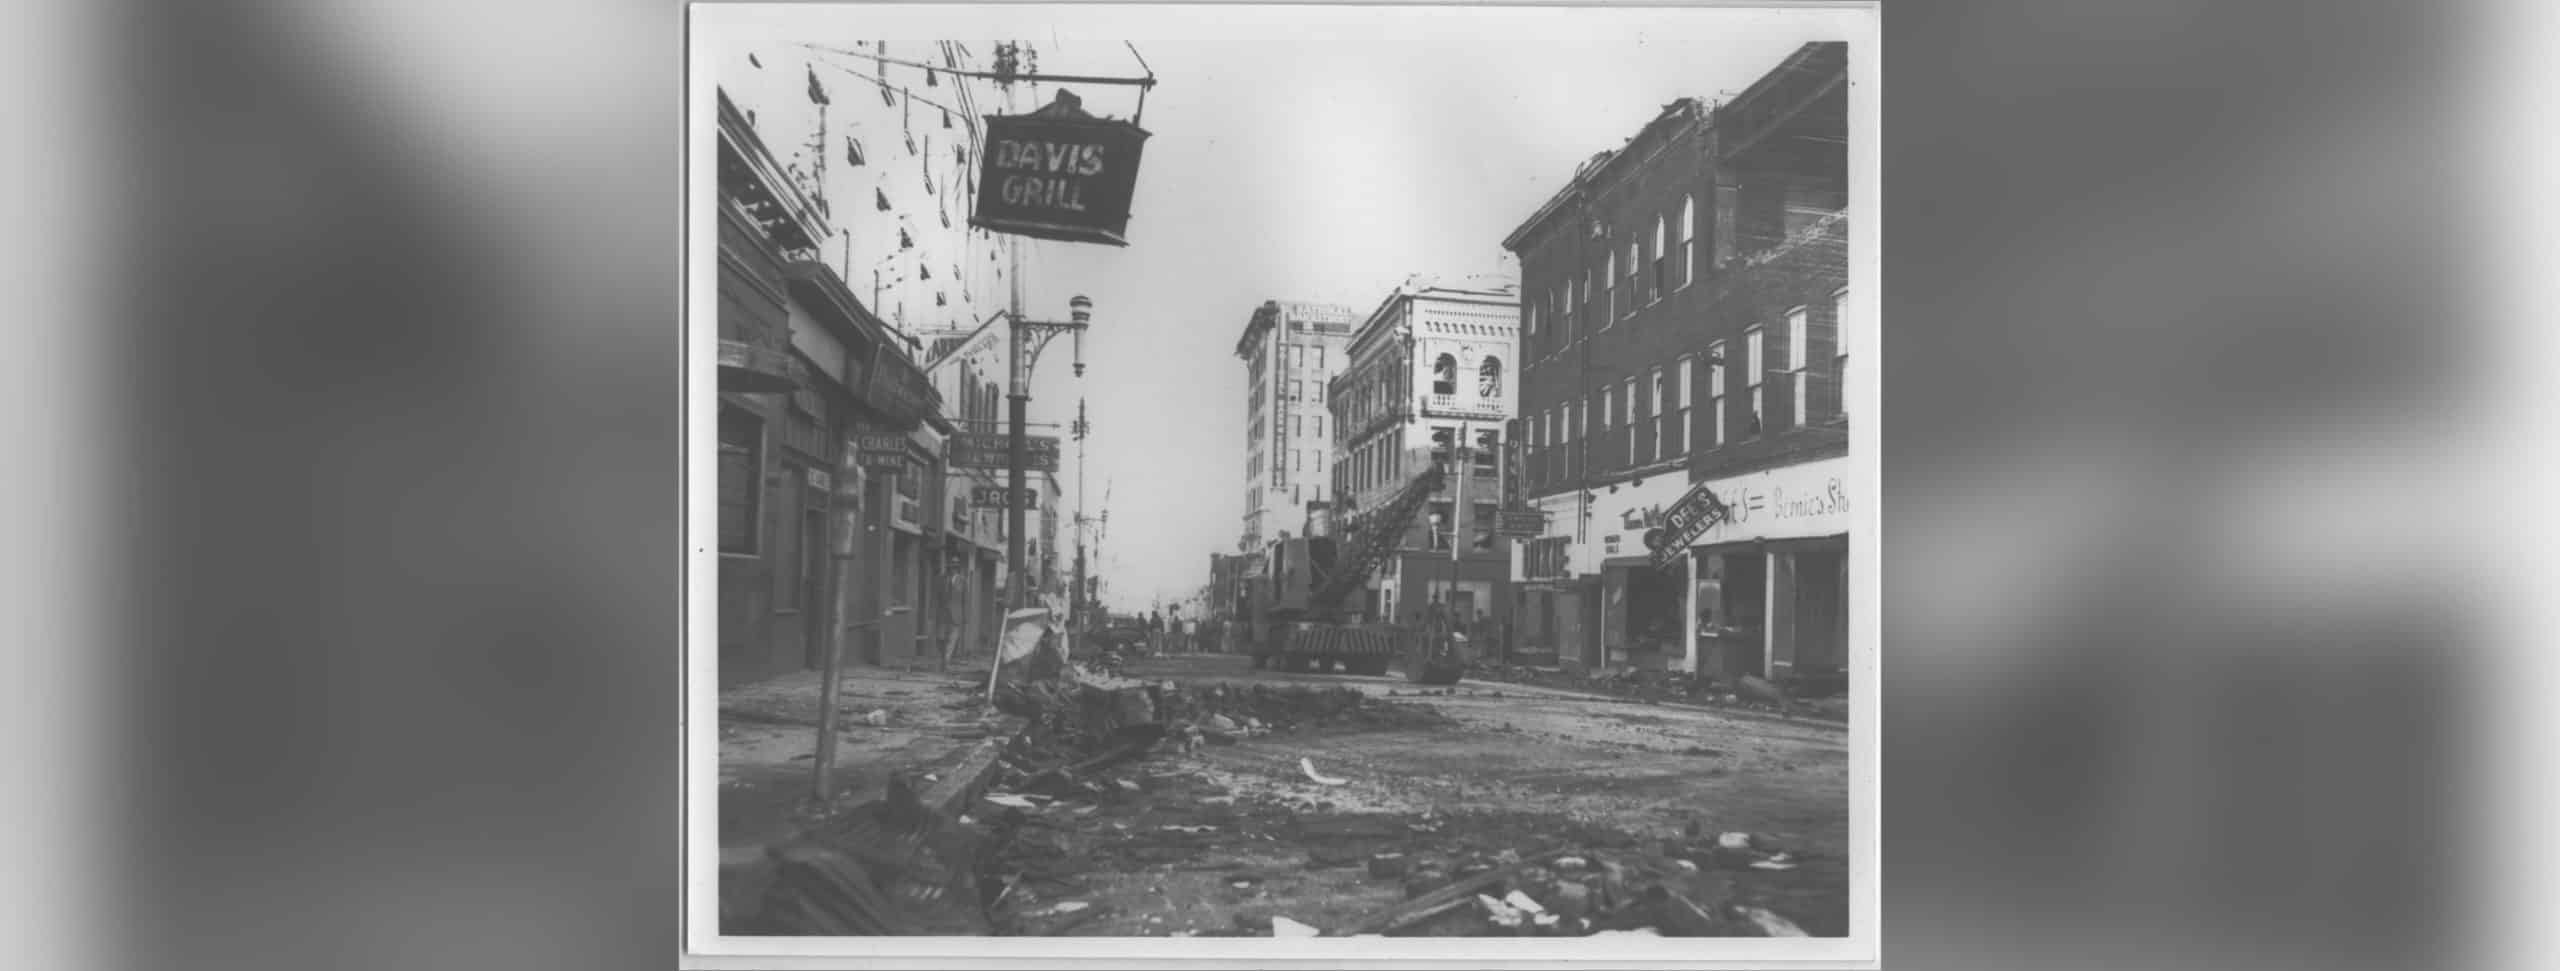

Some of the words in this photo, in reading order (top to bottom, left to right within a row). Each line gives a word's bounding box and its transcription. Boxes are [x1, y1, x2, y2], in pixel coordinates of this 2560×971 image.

[995, 138, 1105, 174] DAVIS
[1001, 171, 1086, 211] GRILL
[1662, 509, 1723, 561] JEWELERS
